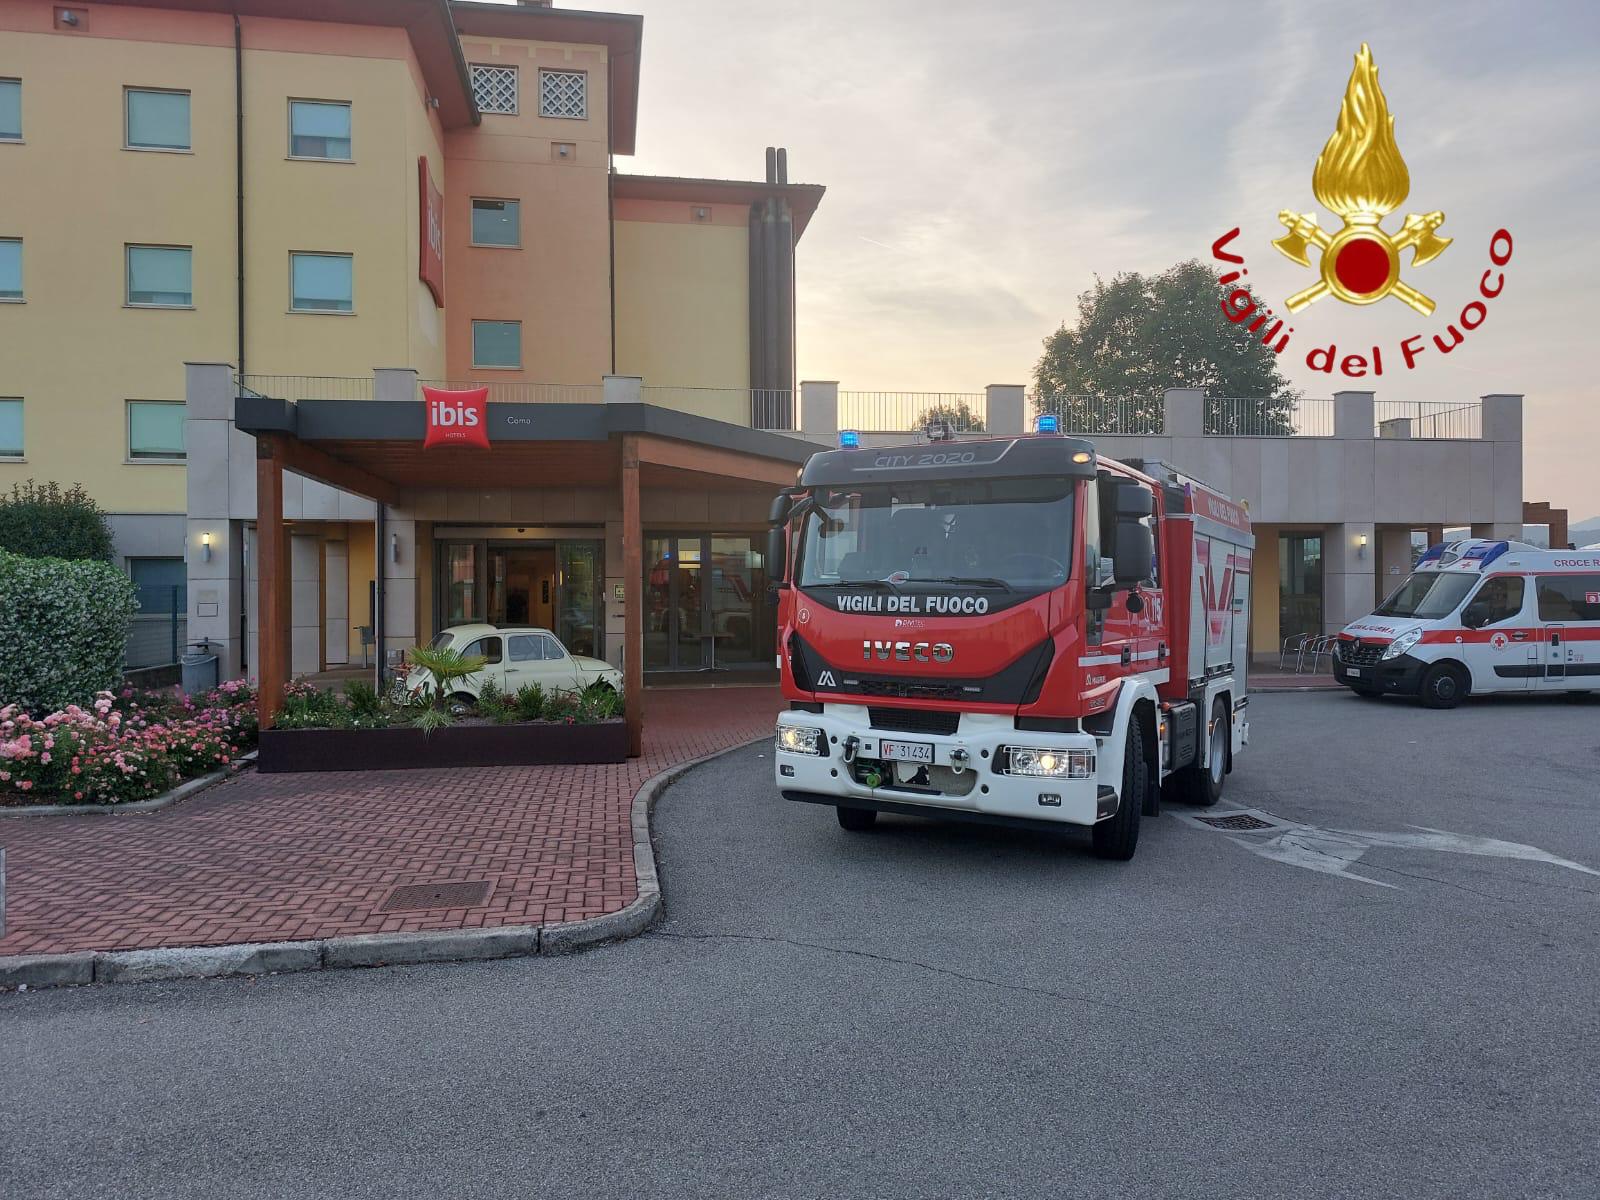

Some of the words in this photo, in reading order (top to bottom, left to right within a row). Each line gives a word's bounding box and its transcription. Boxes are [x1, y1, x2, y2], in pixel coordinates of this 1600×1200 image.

[431, 401, 479, 426] ibis
[507, 416, 531, 425] Como
[874, 454, 914, 468] CITY
[918, 451, 975, 466] 2020
[1553, 559, 1591, 567] CROCE
[837, 595, 882, 612] VIGILI
[887, 595, 921, 613] DEL
[925, 596, 989, 614] FUOCO
[863, 640, 955, 664] IVECO
[883, 743, 895, 756] VF
[900, 745, 930, 760] 31434
